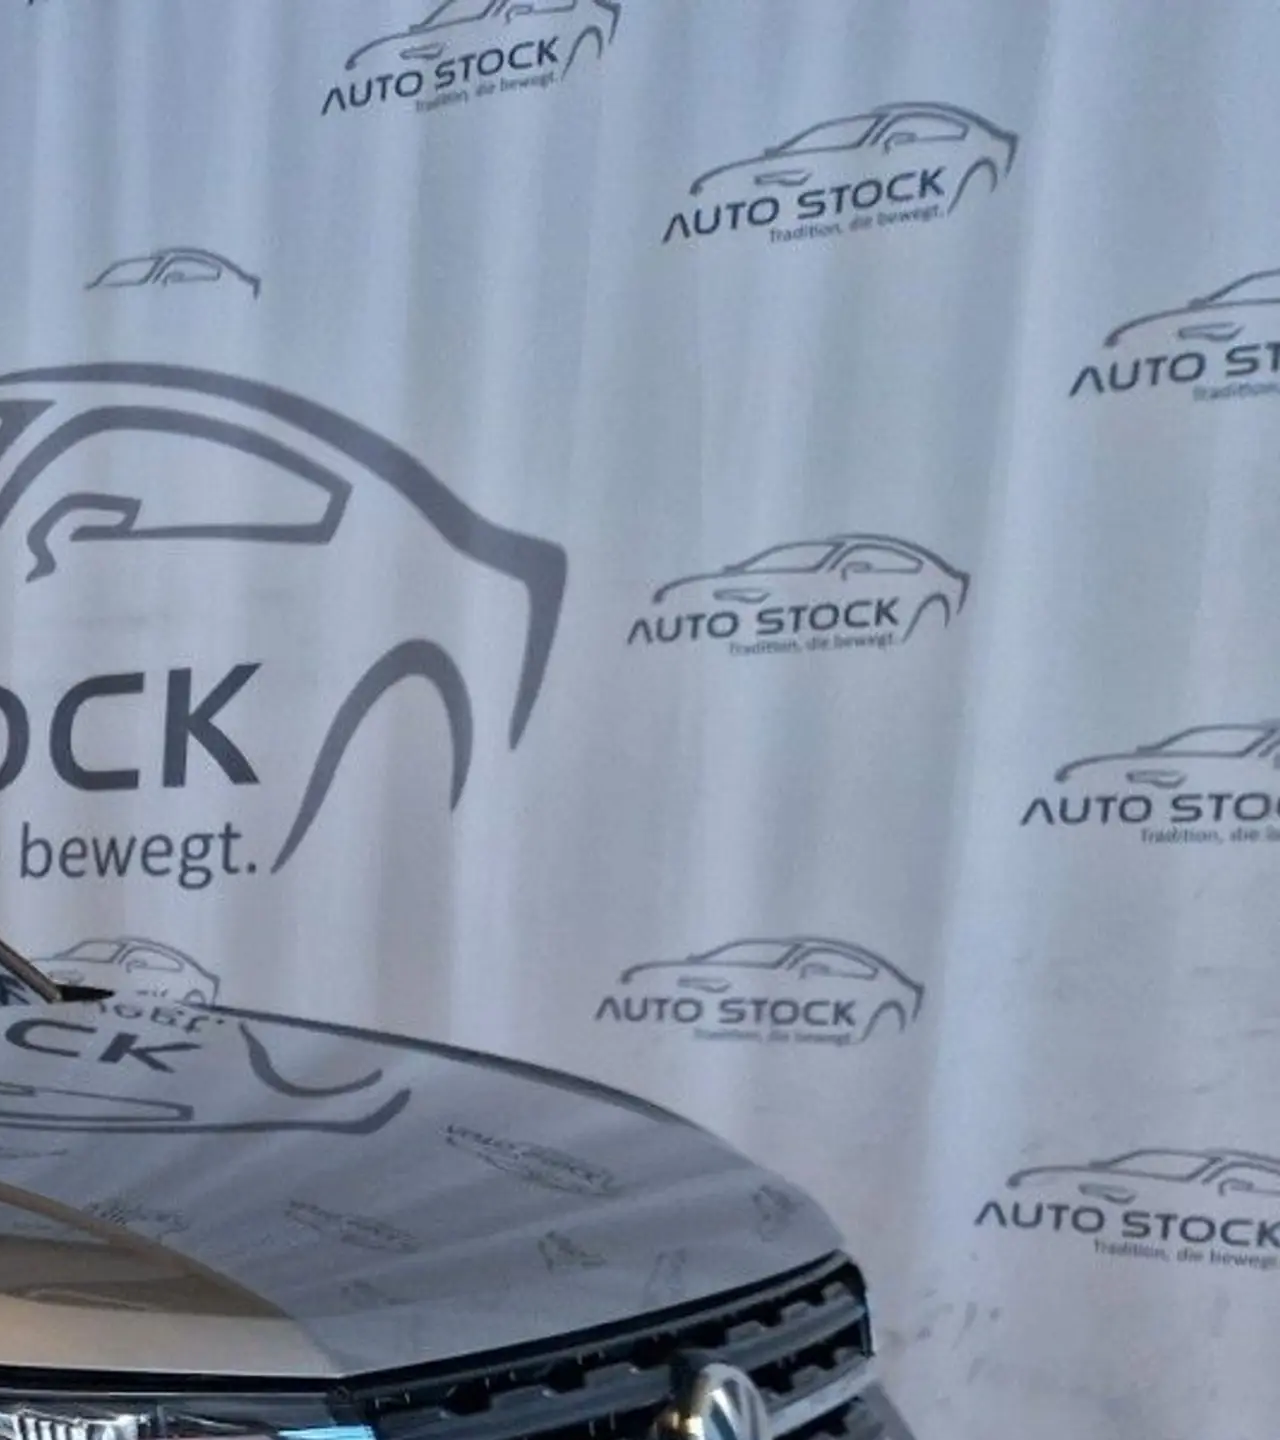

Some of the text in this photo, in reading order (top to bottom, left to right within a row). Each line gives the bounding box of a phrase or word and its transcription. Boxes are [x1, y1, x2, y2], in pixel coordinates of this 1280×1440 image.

[321, 36, 560, 116] AUTO STOCK
[662, 166, 946, 245] AUTO STOCK
[1069, 351, 1207, 397] AUTO
[627, 597, 901, 645] AUTO STOCK
[1020, 793, 1280, 826] AUTO STO
[20, 820, 257, 890] bewegt.
[594, 996, 857, 1027] AUTO STOCK
[974, 1201, 1280, 1248] AUTO STOCK
